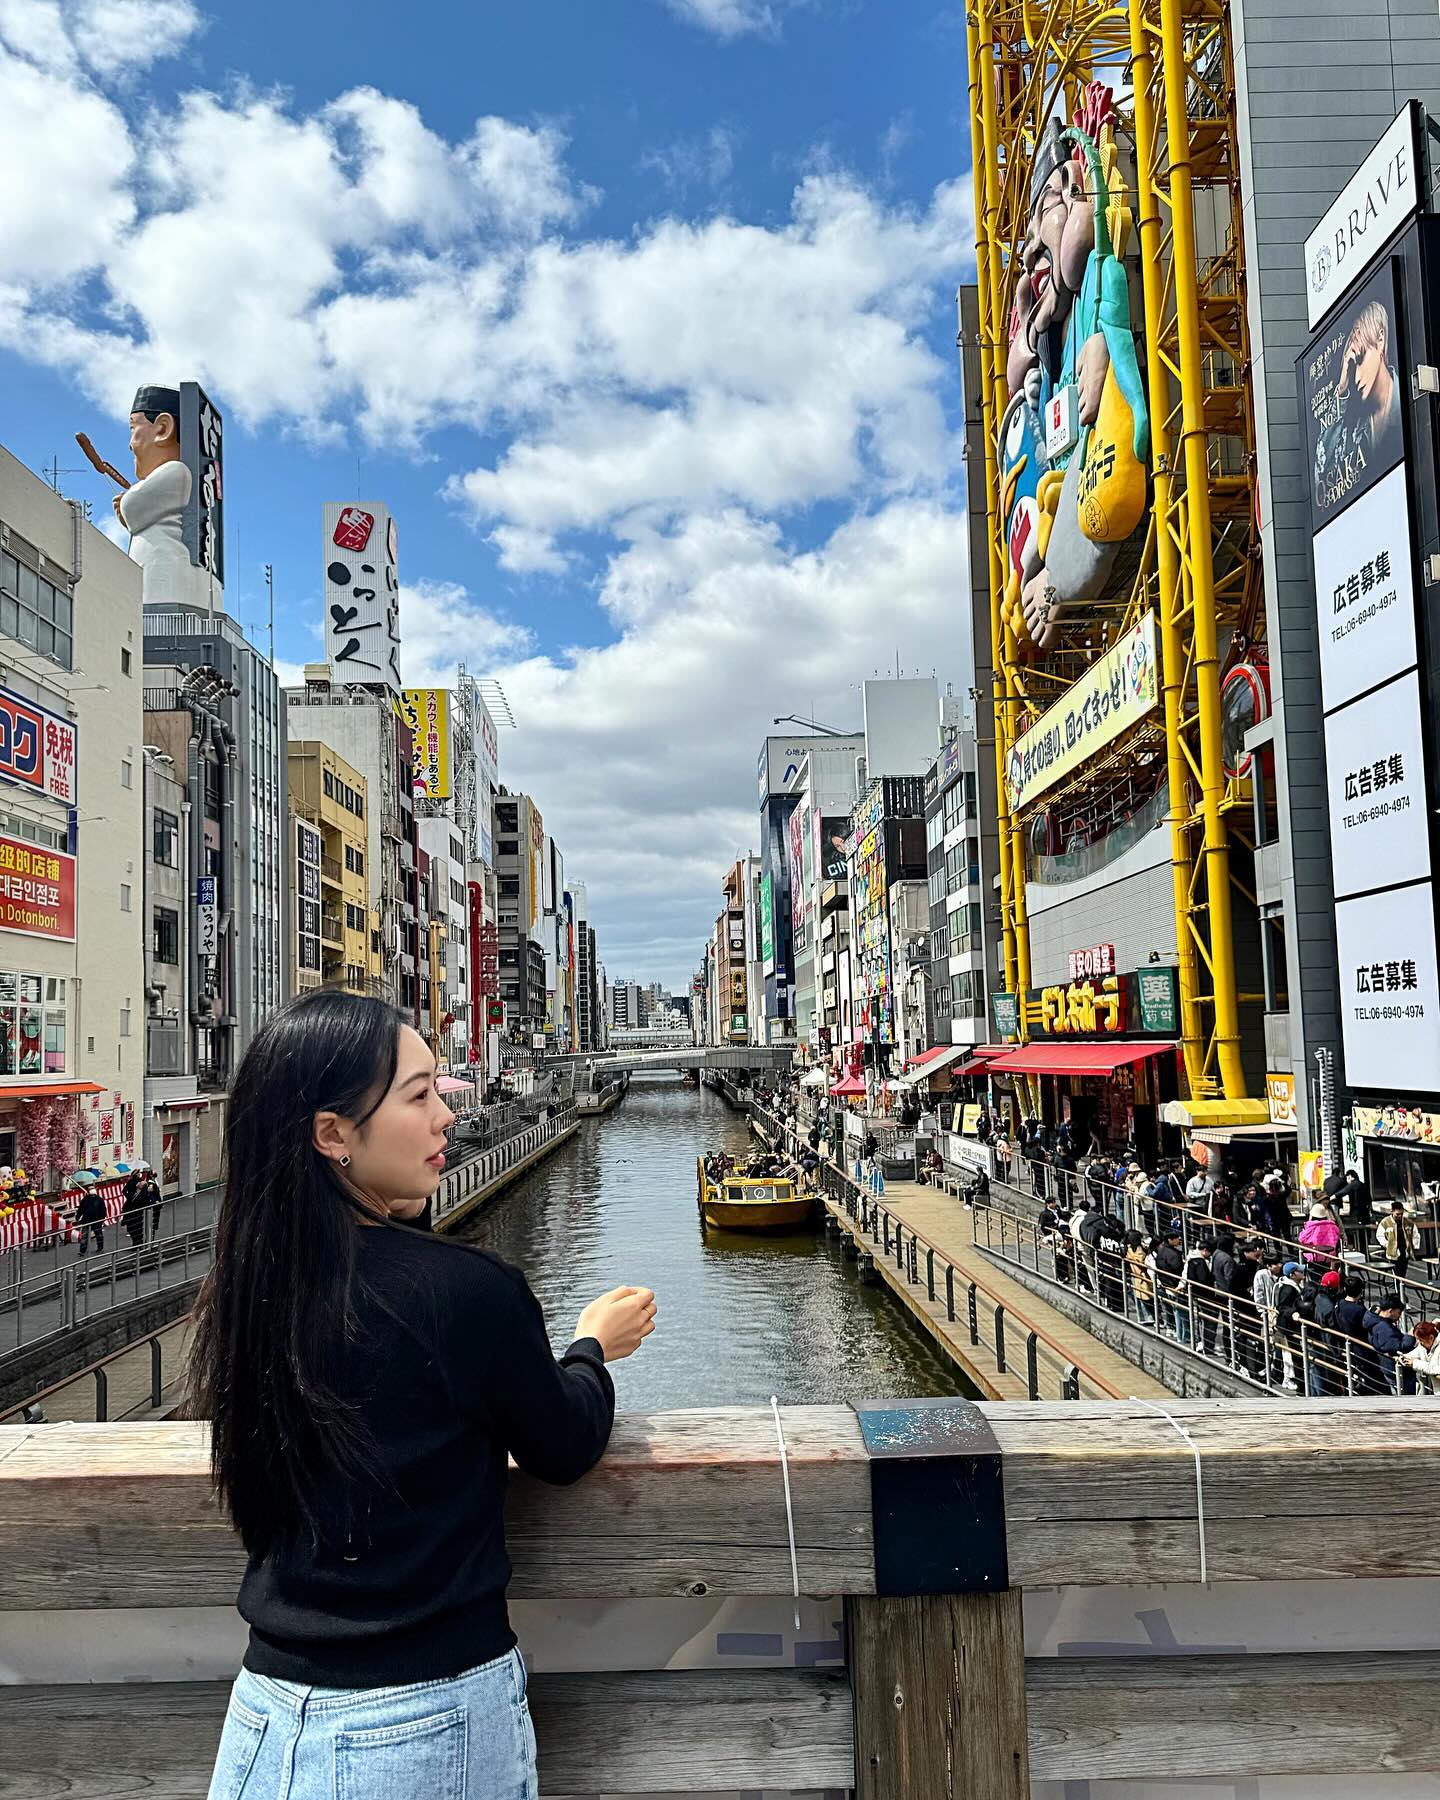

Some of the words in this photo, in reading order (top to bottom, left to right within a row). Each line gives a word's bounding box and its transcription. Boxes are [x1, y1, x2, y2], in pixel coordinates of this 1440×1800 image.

[1334, 145, 1408, 264] BRAVE
[1333, 550, 1391, 615] 広告募集
[327, 561, 383, 671] いっとく
[1331, 590, 1397, 643] TEL:06-6940-4974
[46, 720, 73, 766] 免税
[427, 691, 439, 794] スカウト機能もあるで
[49, 778, 69, 799] FREE
[52, 761, 67, 780] TAX
[1344, 753, 1404, 802] 広告募集
[1342, 795, 1411, 829] TEL:06-6940-4974
[201, 880, 214, 904] 焼肉
[202, 905, 214, 952] いろりや
[1142, 975, 1170, 1002] 薬
[1356, 959, 1418, 994] 広告募集
[1354, 1005, 1425, 1020] TEL:06-6940-4974
